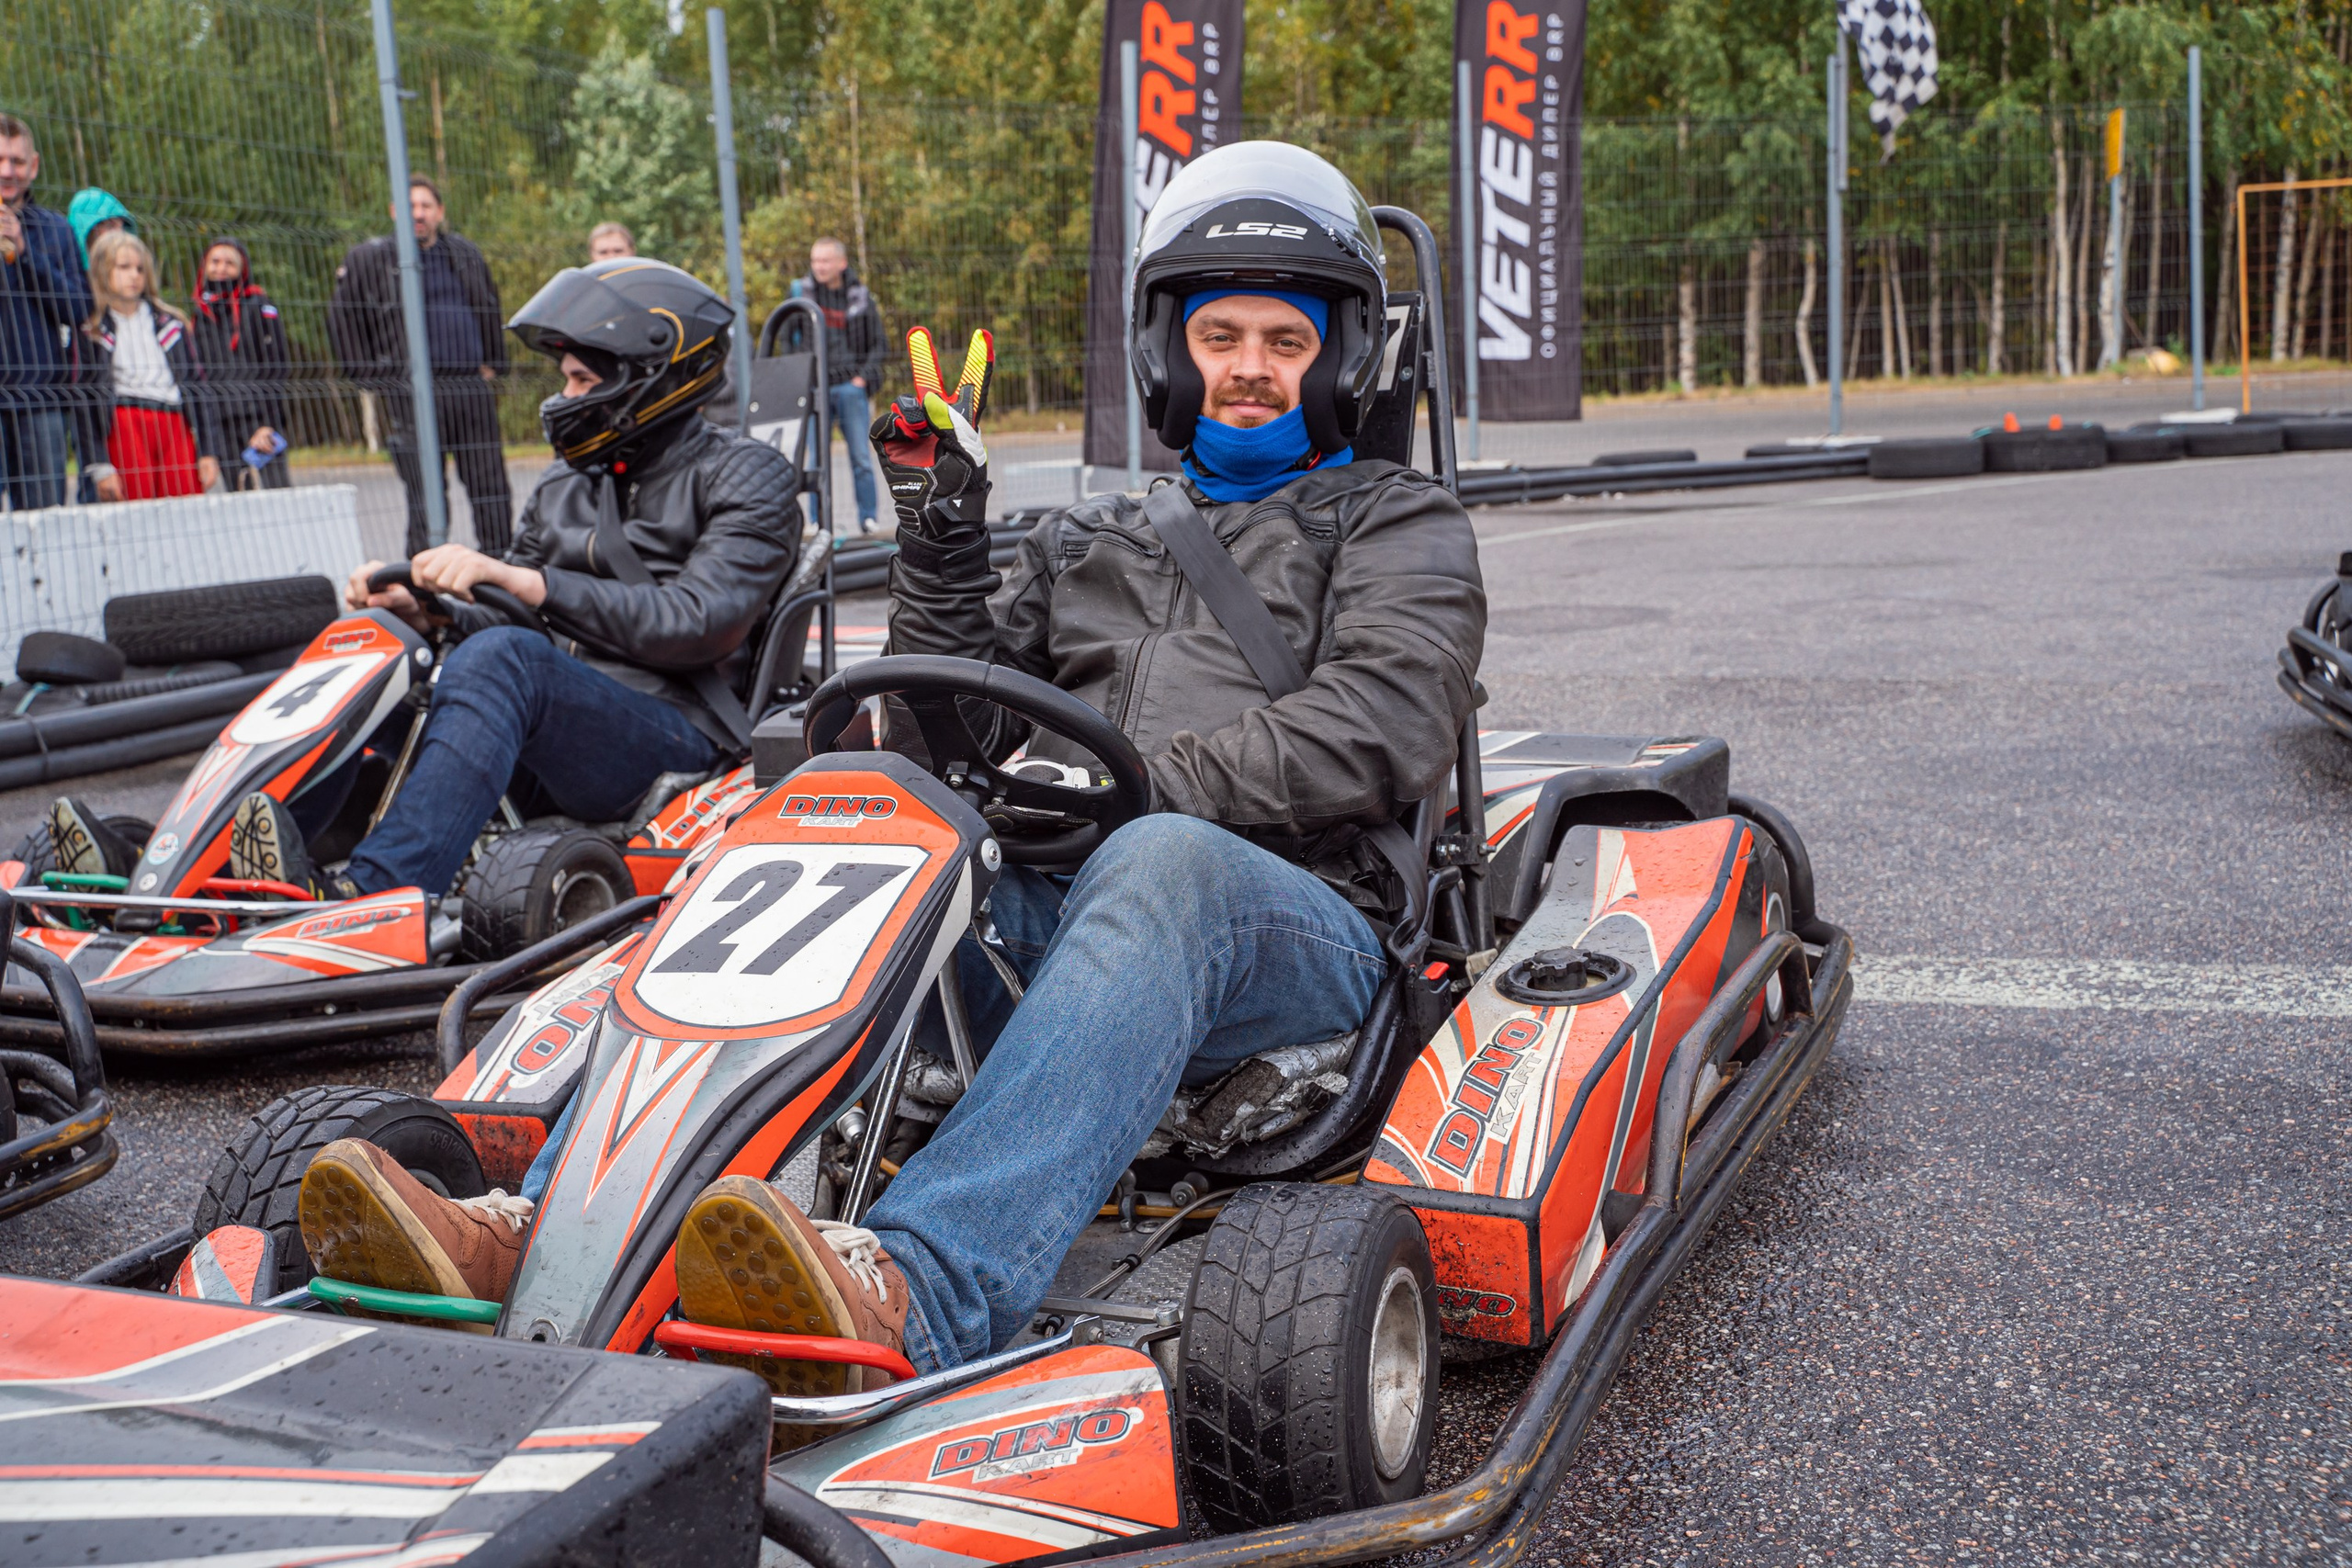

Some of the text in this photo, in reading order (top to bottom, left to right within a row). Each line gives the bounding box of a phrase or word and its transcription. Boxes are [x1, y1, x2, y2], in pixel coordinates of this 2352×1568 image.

[1542, 74, 1560, 160] ДИЛЕР
[1478, 0, 1539, 360] VETERR
[1205, 222, 1308, 241] LS2
[1538, 171, 1558, 359] ОФИЦИАЛЬНЫЙ
[325, 631, 376, 648] DINO
[265, 663, 354, 719] 4
[780, 796, 897, 818] DINO
[801, 818, 860, 826] KART
[299, 909, 402, 935] DINO
[650, 860, 911, 976] 27
[1427, 1018, 1544, 1179] DINO
[1490, 1052, 1542, 1137] KART
[932, 1410, 1131, 1477] DINO
[978, 1449, 1079, 1479] KART
